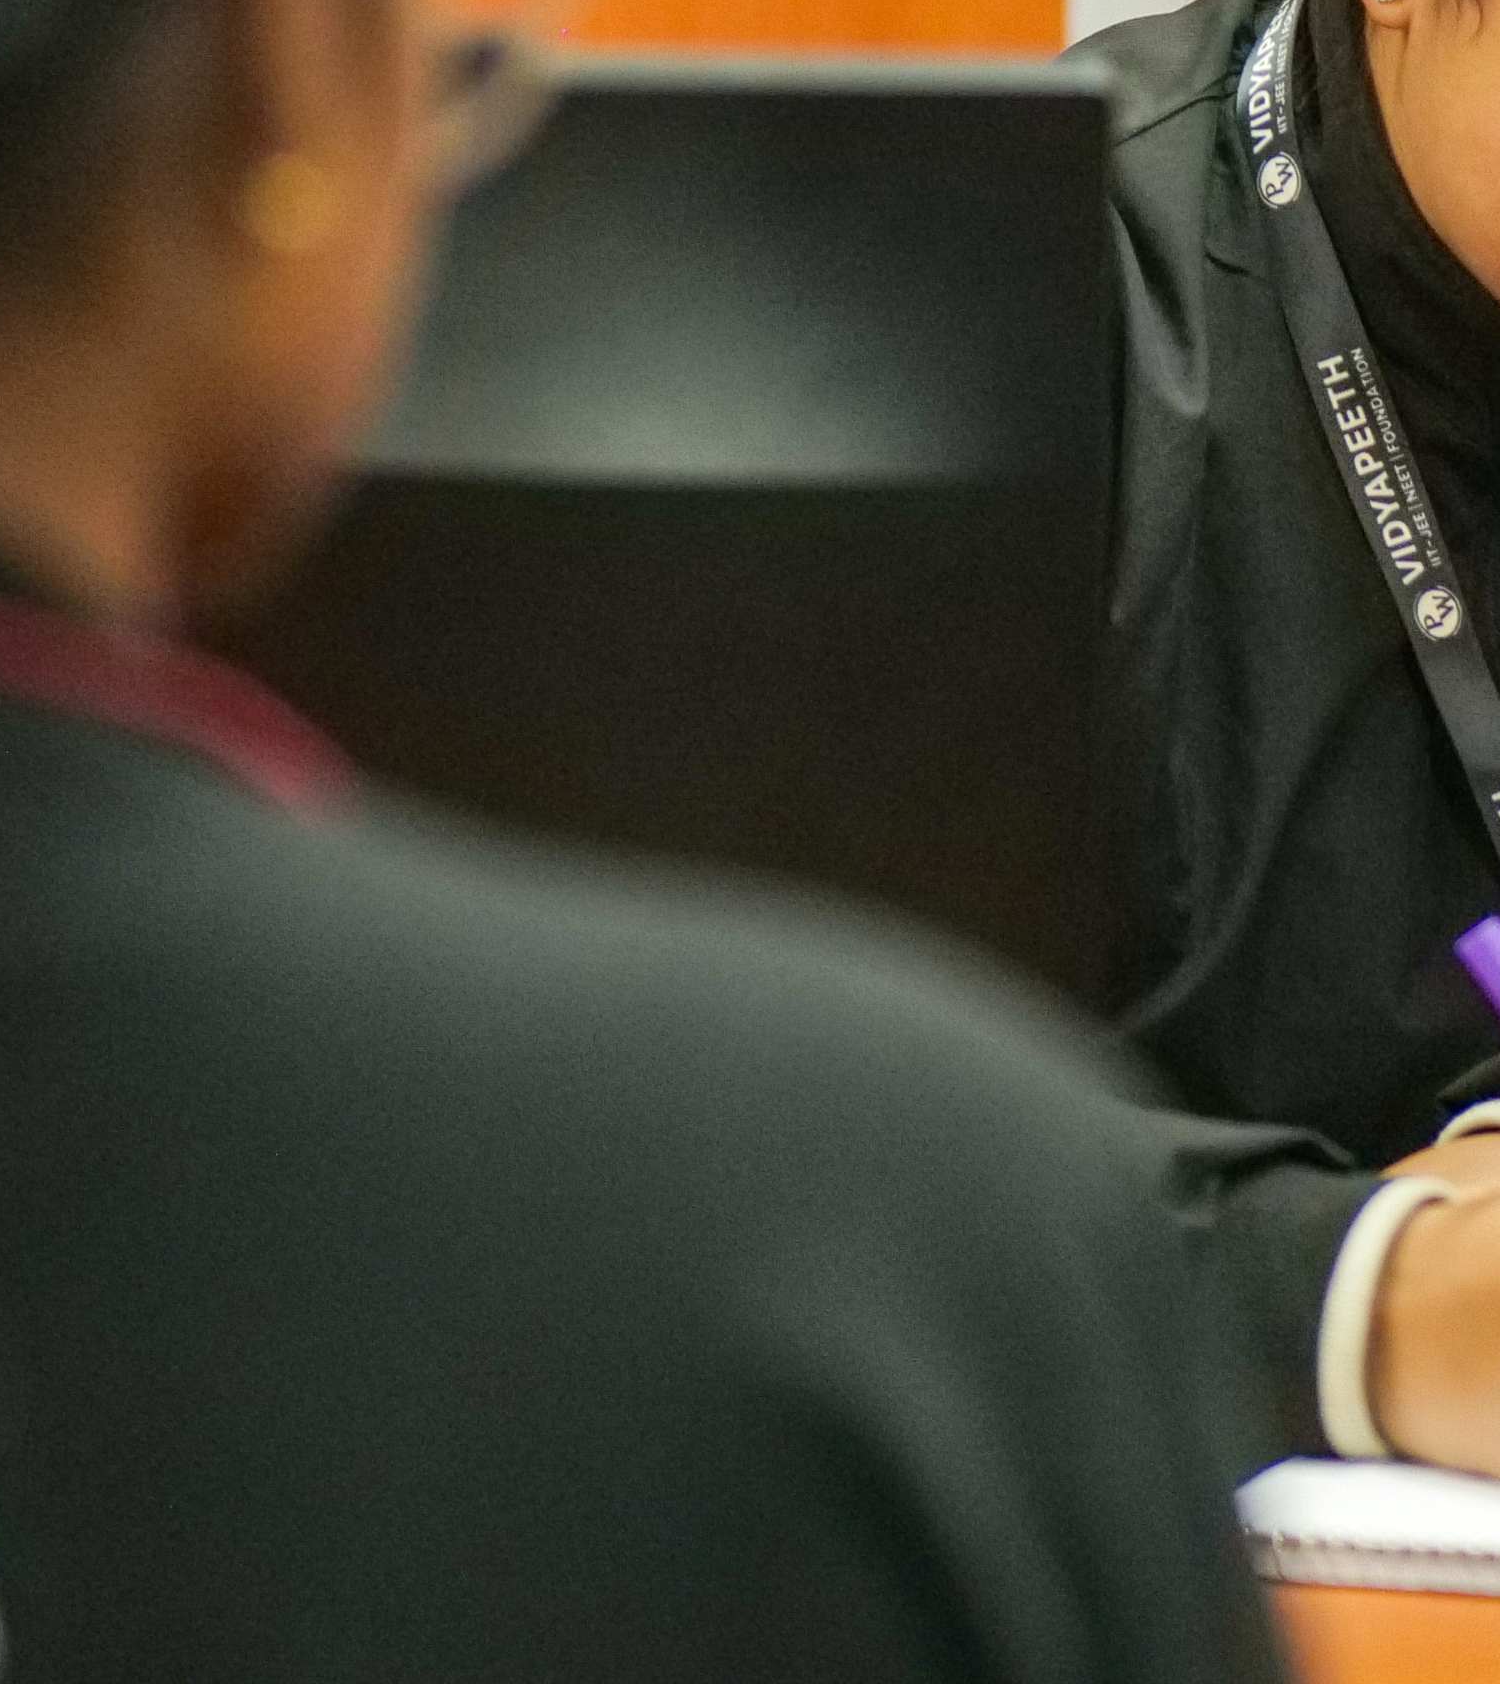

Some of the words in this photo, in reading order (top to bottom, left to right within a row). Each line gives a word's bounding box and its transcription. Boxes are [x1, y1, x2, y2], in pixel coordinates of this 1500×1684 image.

[1350, 347, 1400, 454] FOUNDATION
[1317, 355, 1425, 586] VIDYAPEETH
[1394, 464, 1419, 504] NEET
